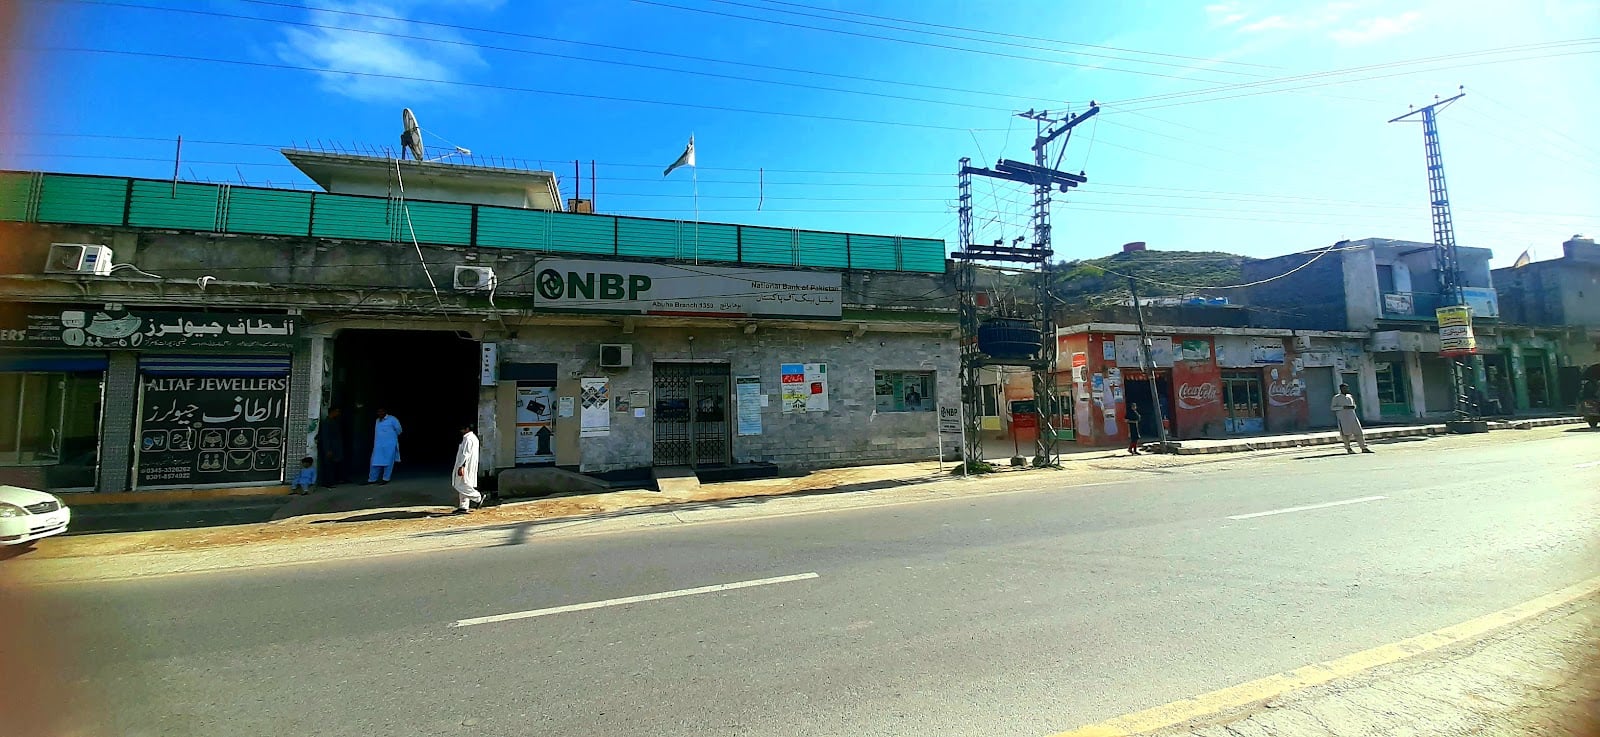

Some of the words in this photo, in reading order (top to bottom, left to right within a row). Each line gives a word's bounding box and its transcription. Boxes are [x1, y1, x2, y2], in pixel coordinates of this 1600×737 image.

[567, 271, 652, 301] NBP
[751, 281, 781, 290] National
[783, 283, 801, 291] Bank
[811, 284, 839, 292] Pakistan
[674, 301, 698, 309] Branch
[144, 316, 224, 338] جیولرز
[149, 378, 195, 391] ALTAF
[197, 378, 286, 392] JEWELLERS
[144, 399, 200, 425] جیولرز
[202, 396, 283, 423] الطاف
